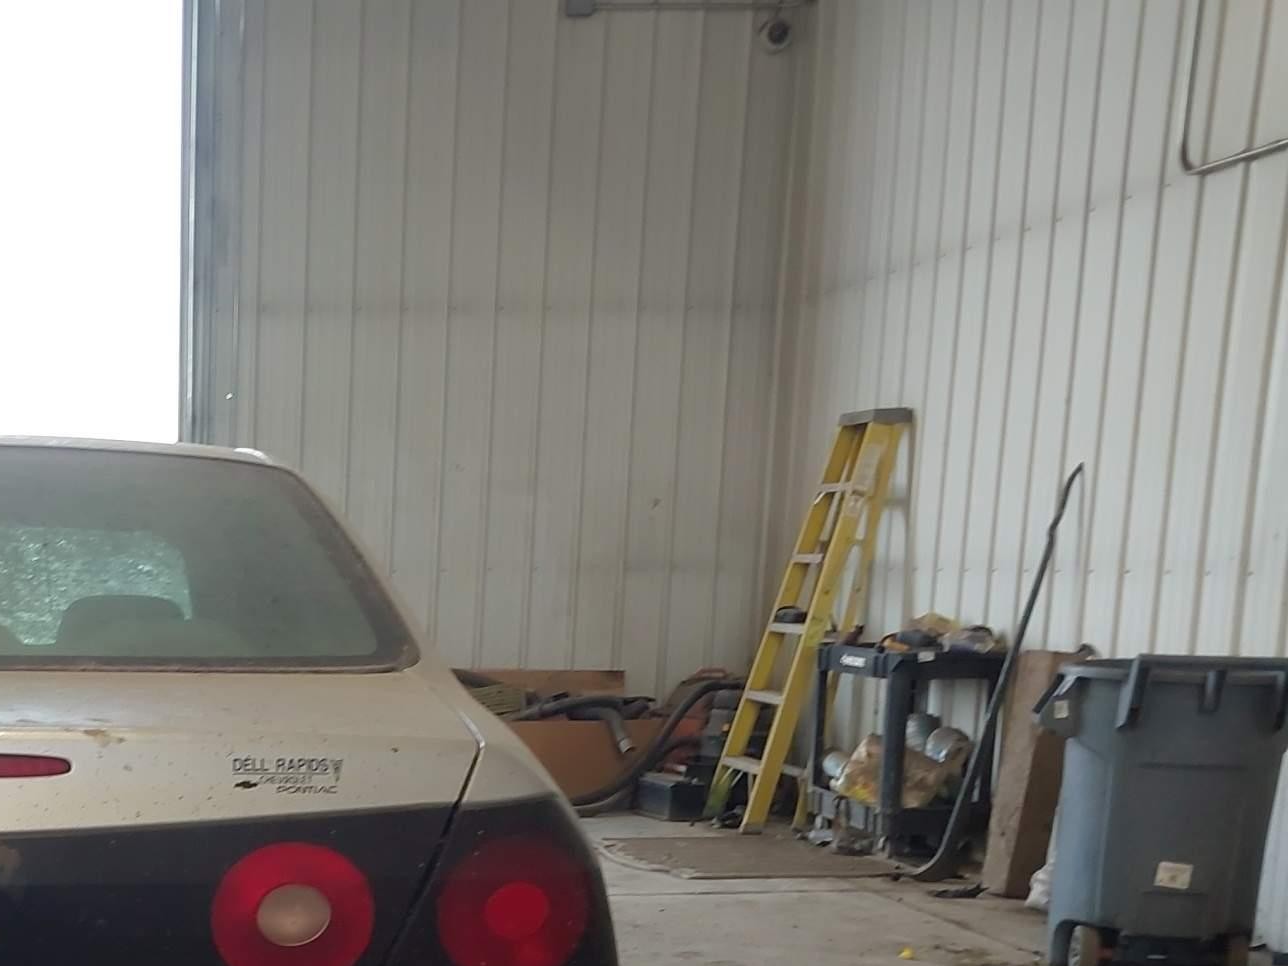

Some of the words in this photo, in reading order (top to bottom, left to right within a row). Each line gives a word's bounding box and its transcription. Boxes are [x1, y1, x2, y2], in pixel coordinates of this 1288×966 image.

[233, 758, 270, 772] DELL
[276, 758, 329, 772] RAPIDS
[276, 785, 339, 794] PONTIAC
